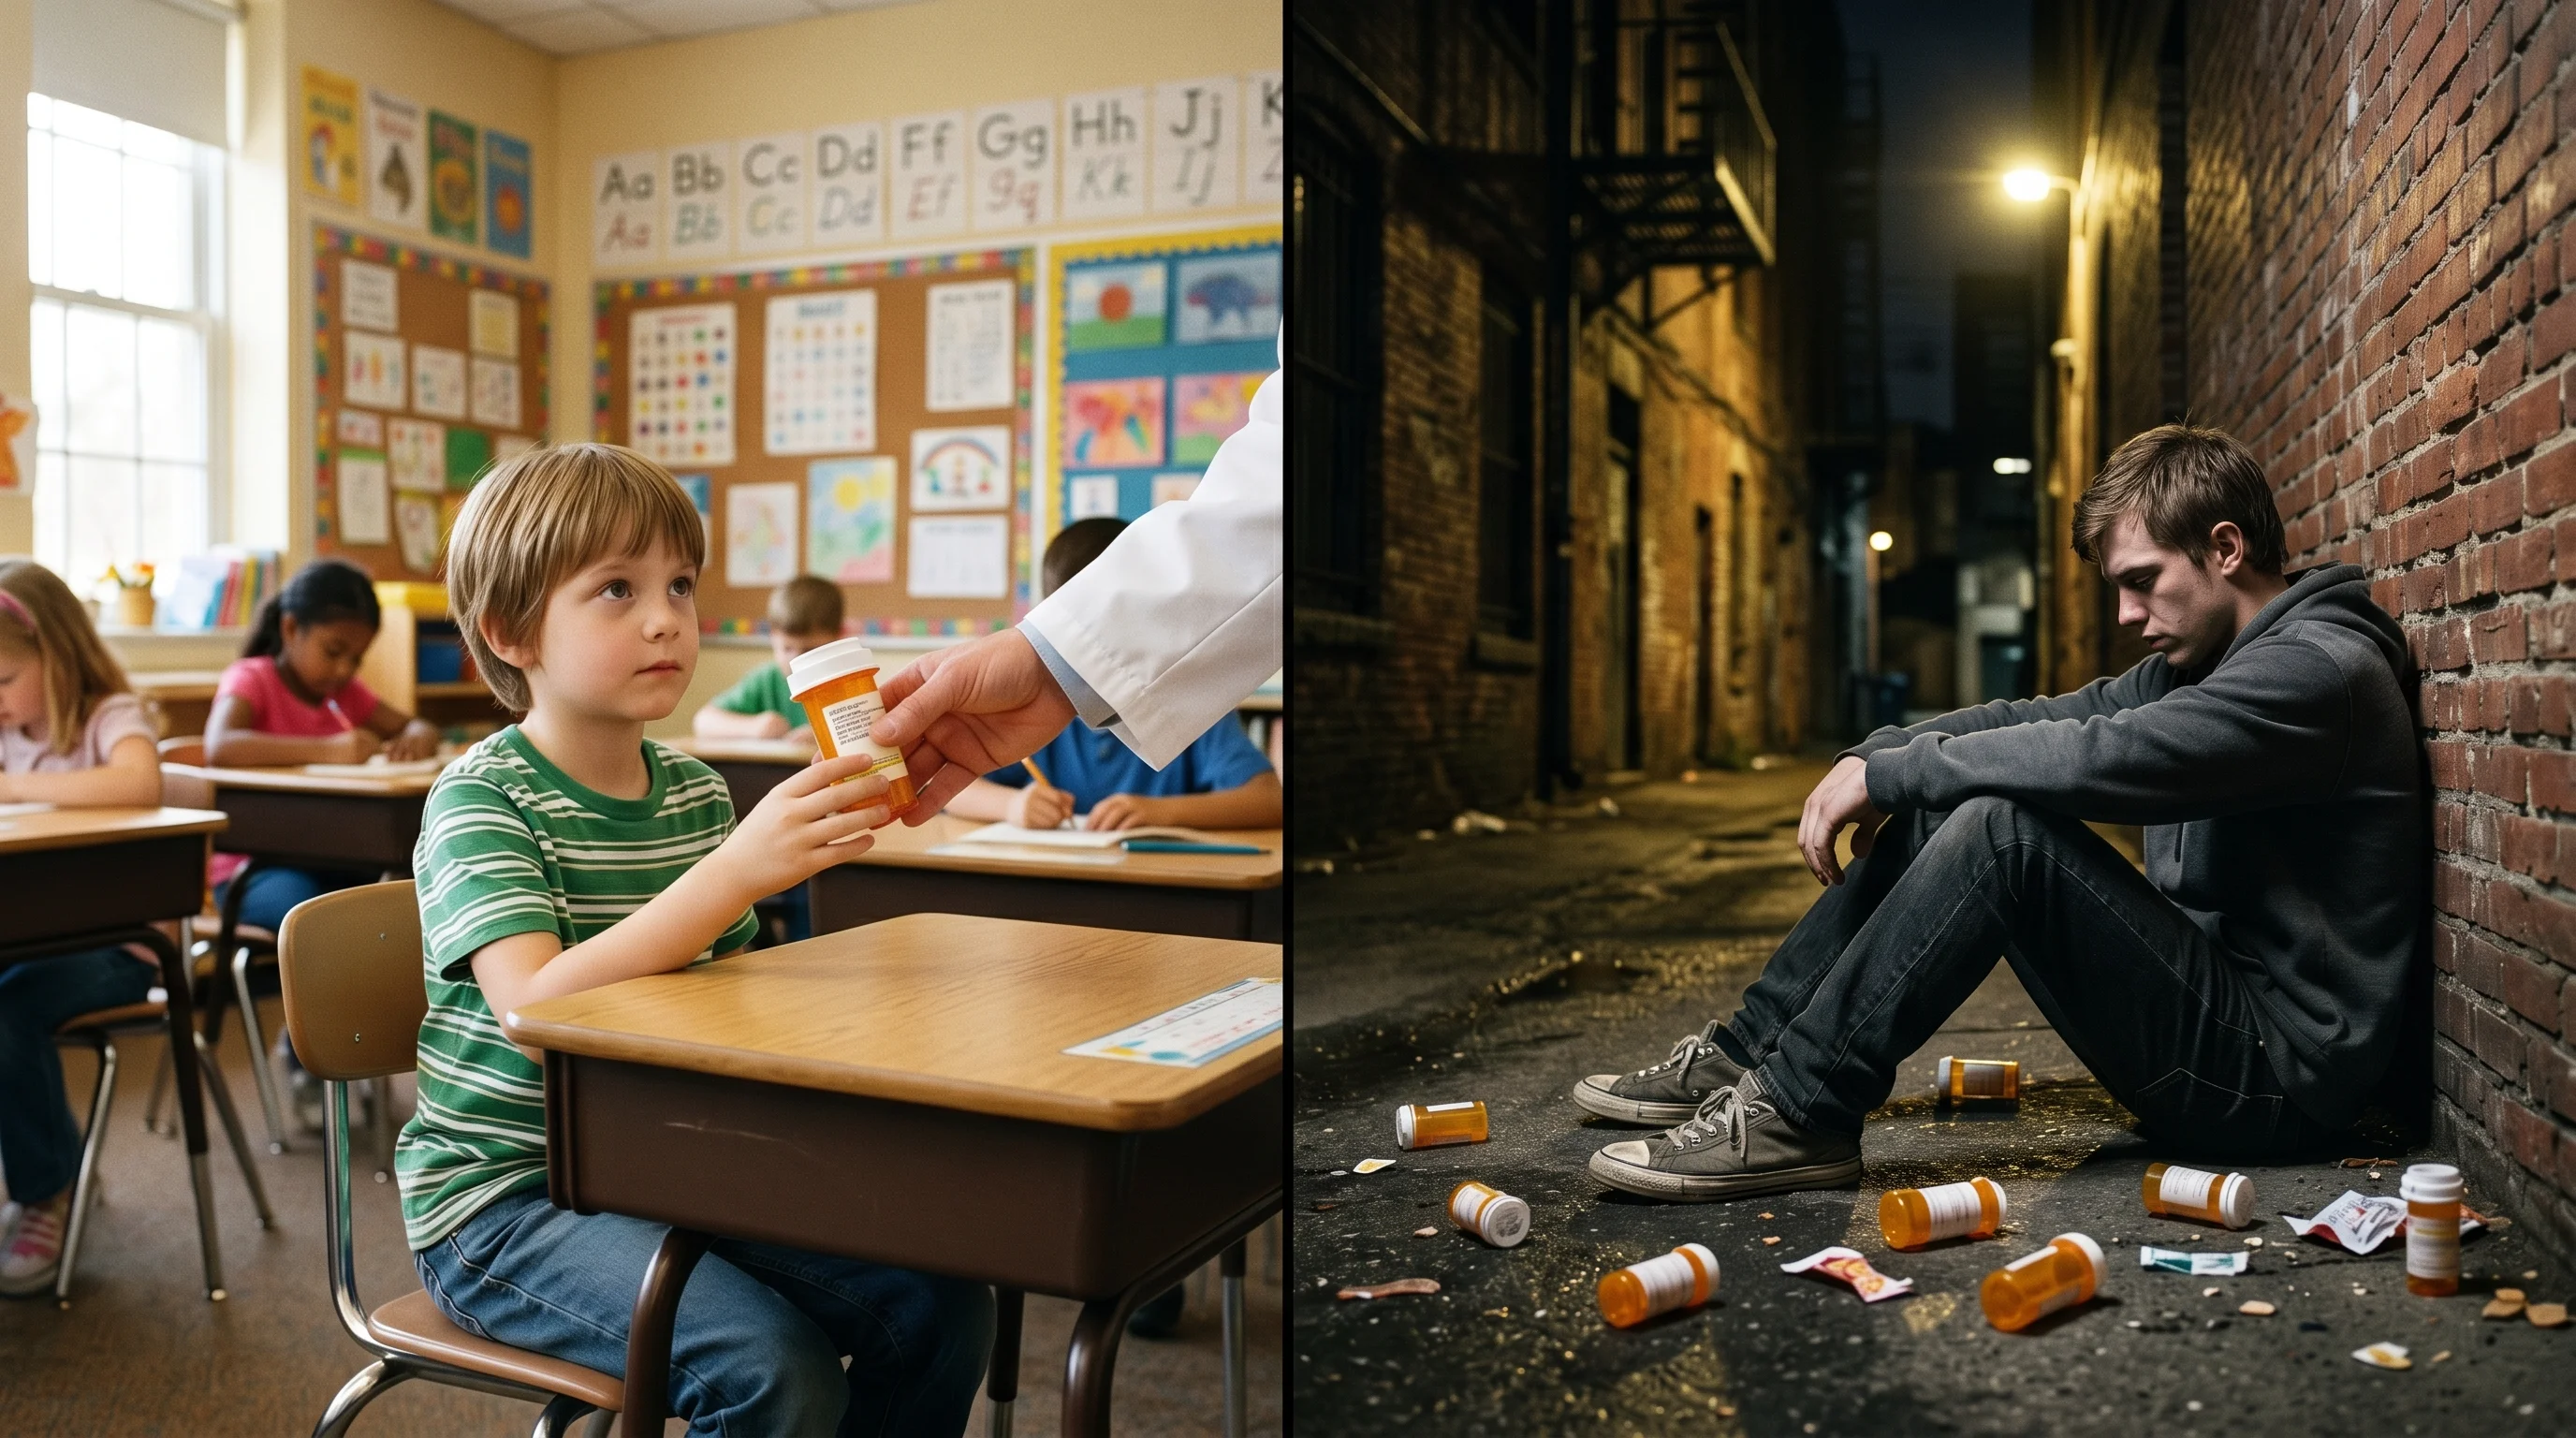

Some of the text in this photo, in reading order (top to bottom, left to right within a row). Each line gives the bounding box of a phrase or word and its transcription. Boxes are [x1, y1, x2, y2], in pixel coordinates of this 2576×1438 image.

[977, 111, 1047, 170] Gg
[1072, 99, 1135, 148] Hh
[1170, 88, 1222, 151] Jj
[742, 142, 798, 187] Cc
[817, 130, 878, 179] Dd
[901, 120, 954, 169] Ff
[599, 162, 654, 205] Aa
[672, 153, 725, 197] Bb
